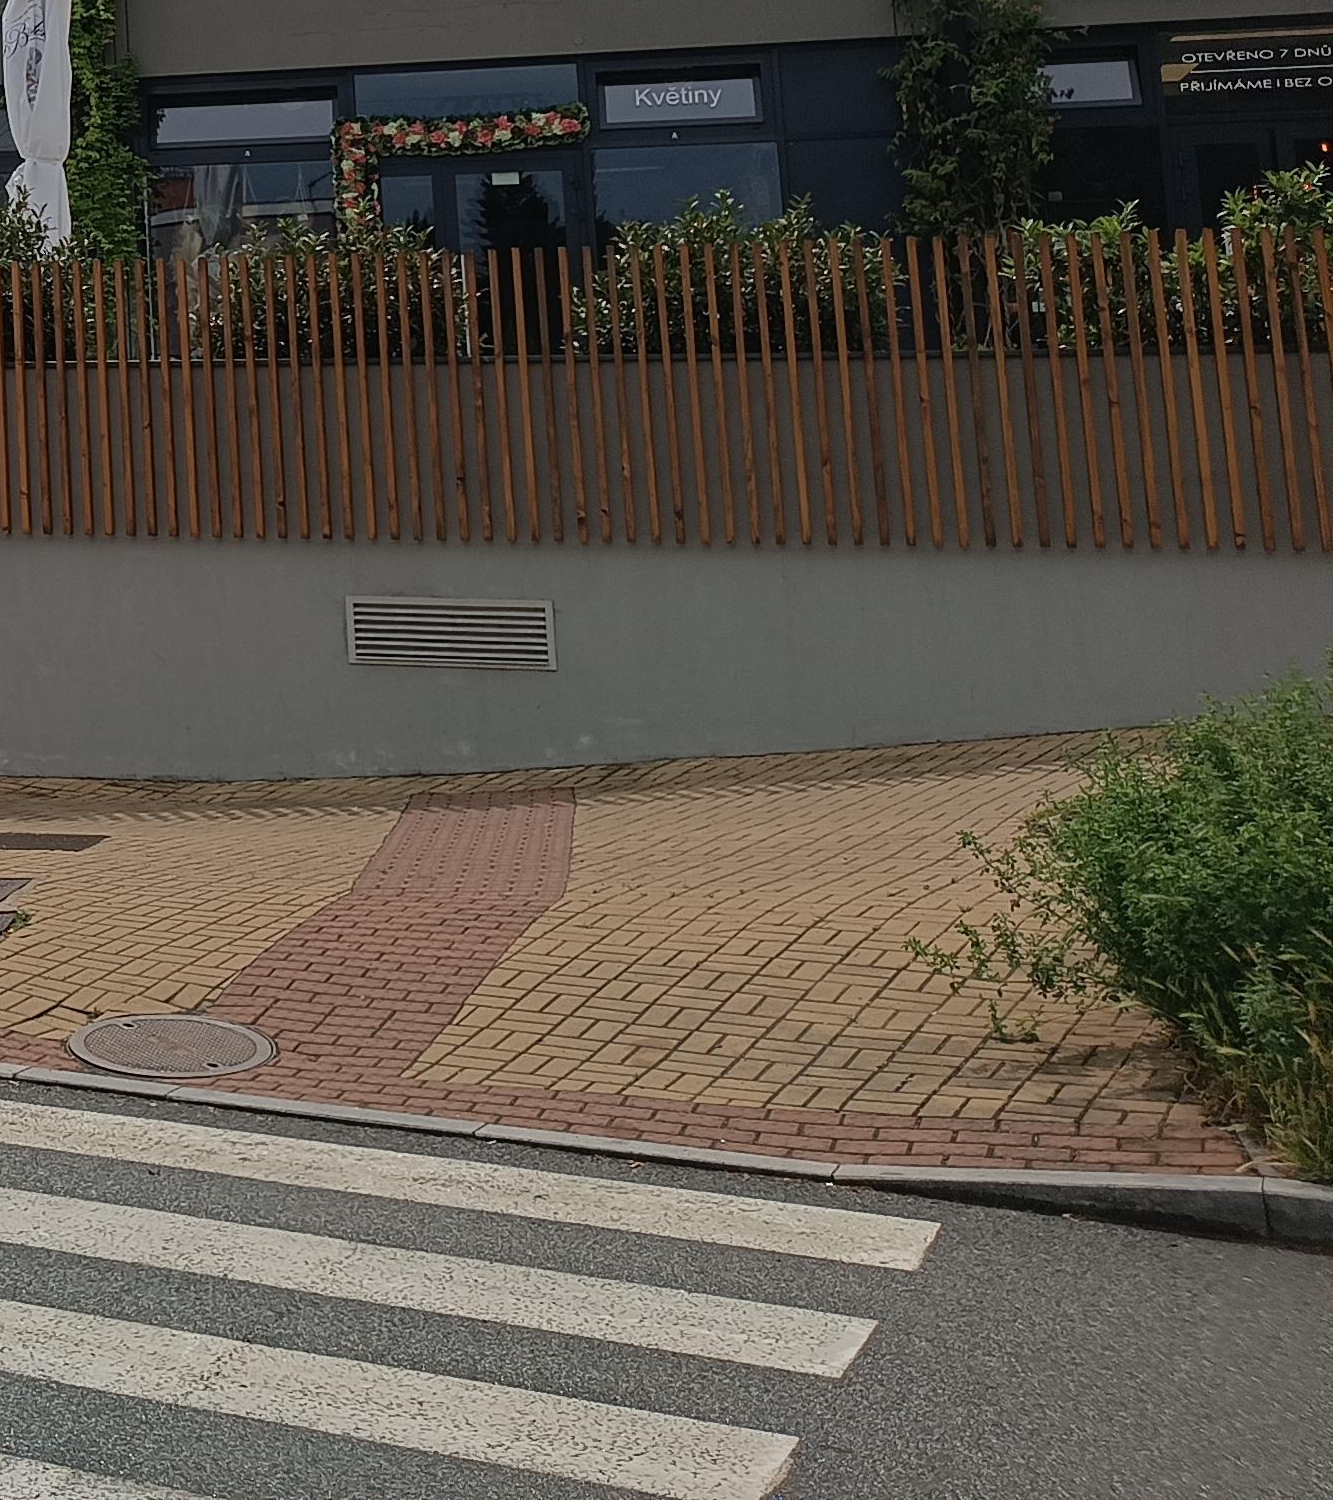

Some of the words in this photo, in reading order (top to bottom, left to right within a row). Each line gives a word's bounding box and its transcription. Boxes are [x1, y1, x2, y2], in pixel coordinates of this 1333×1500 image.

[1181, 49, 1274, 64] OTEVŘENO
[1279, 49, 1288, 59] 7
[1294, 44, 1332, 58] DNŮ
[1180, 78, 1272, 92] PŘIJÍMÁME
[1284, 77, 1313, 88] BEZ
[1318, 76, 1333, 87] O
[635, 86, 722, 108] Květiny
